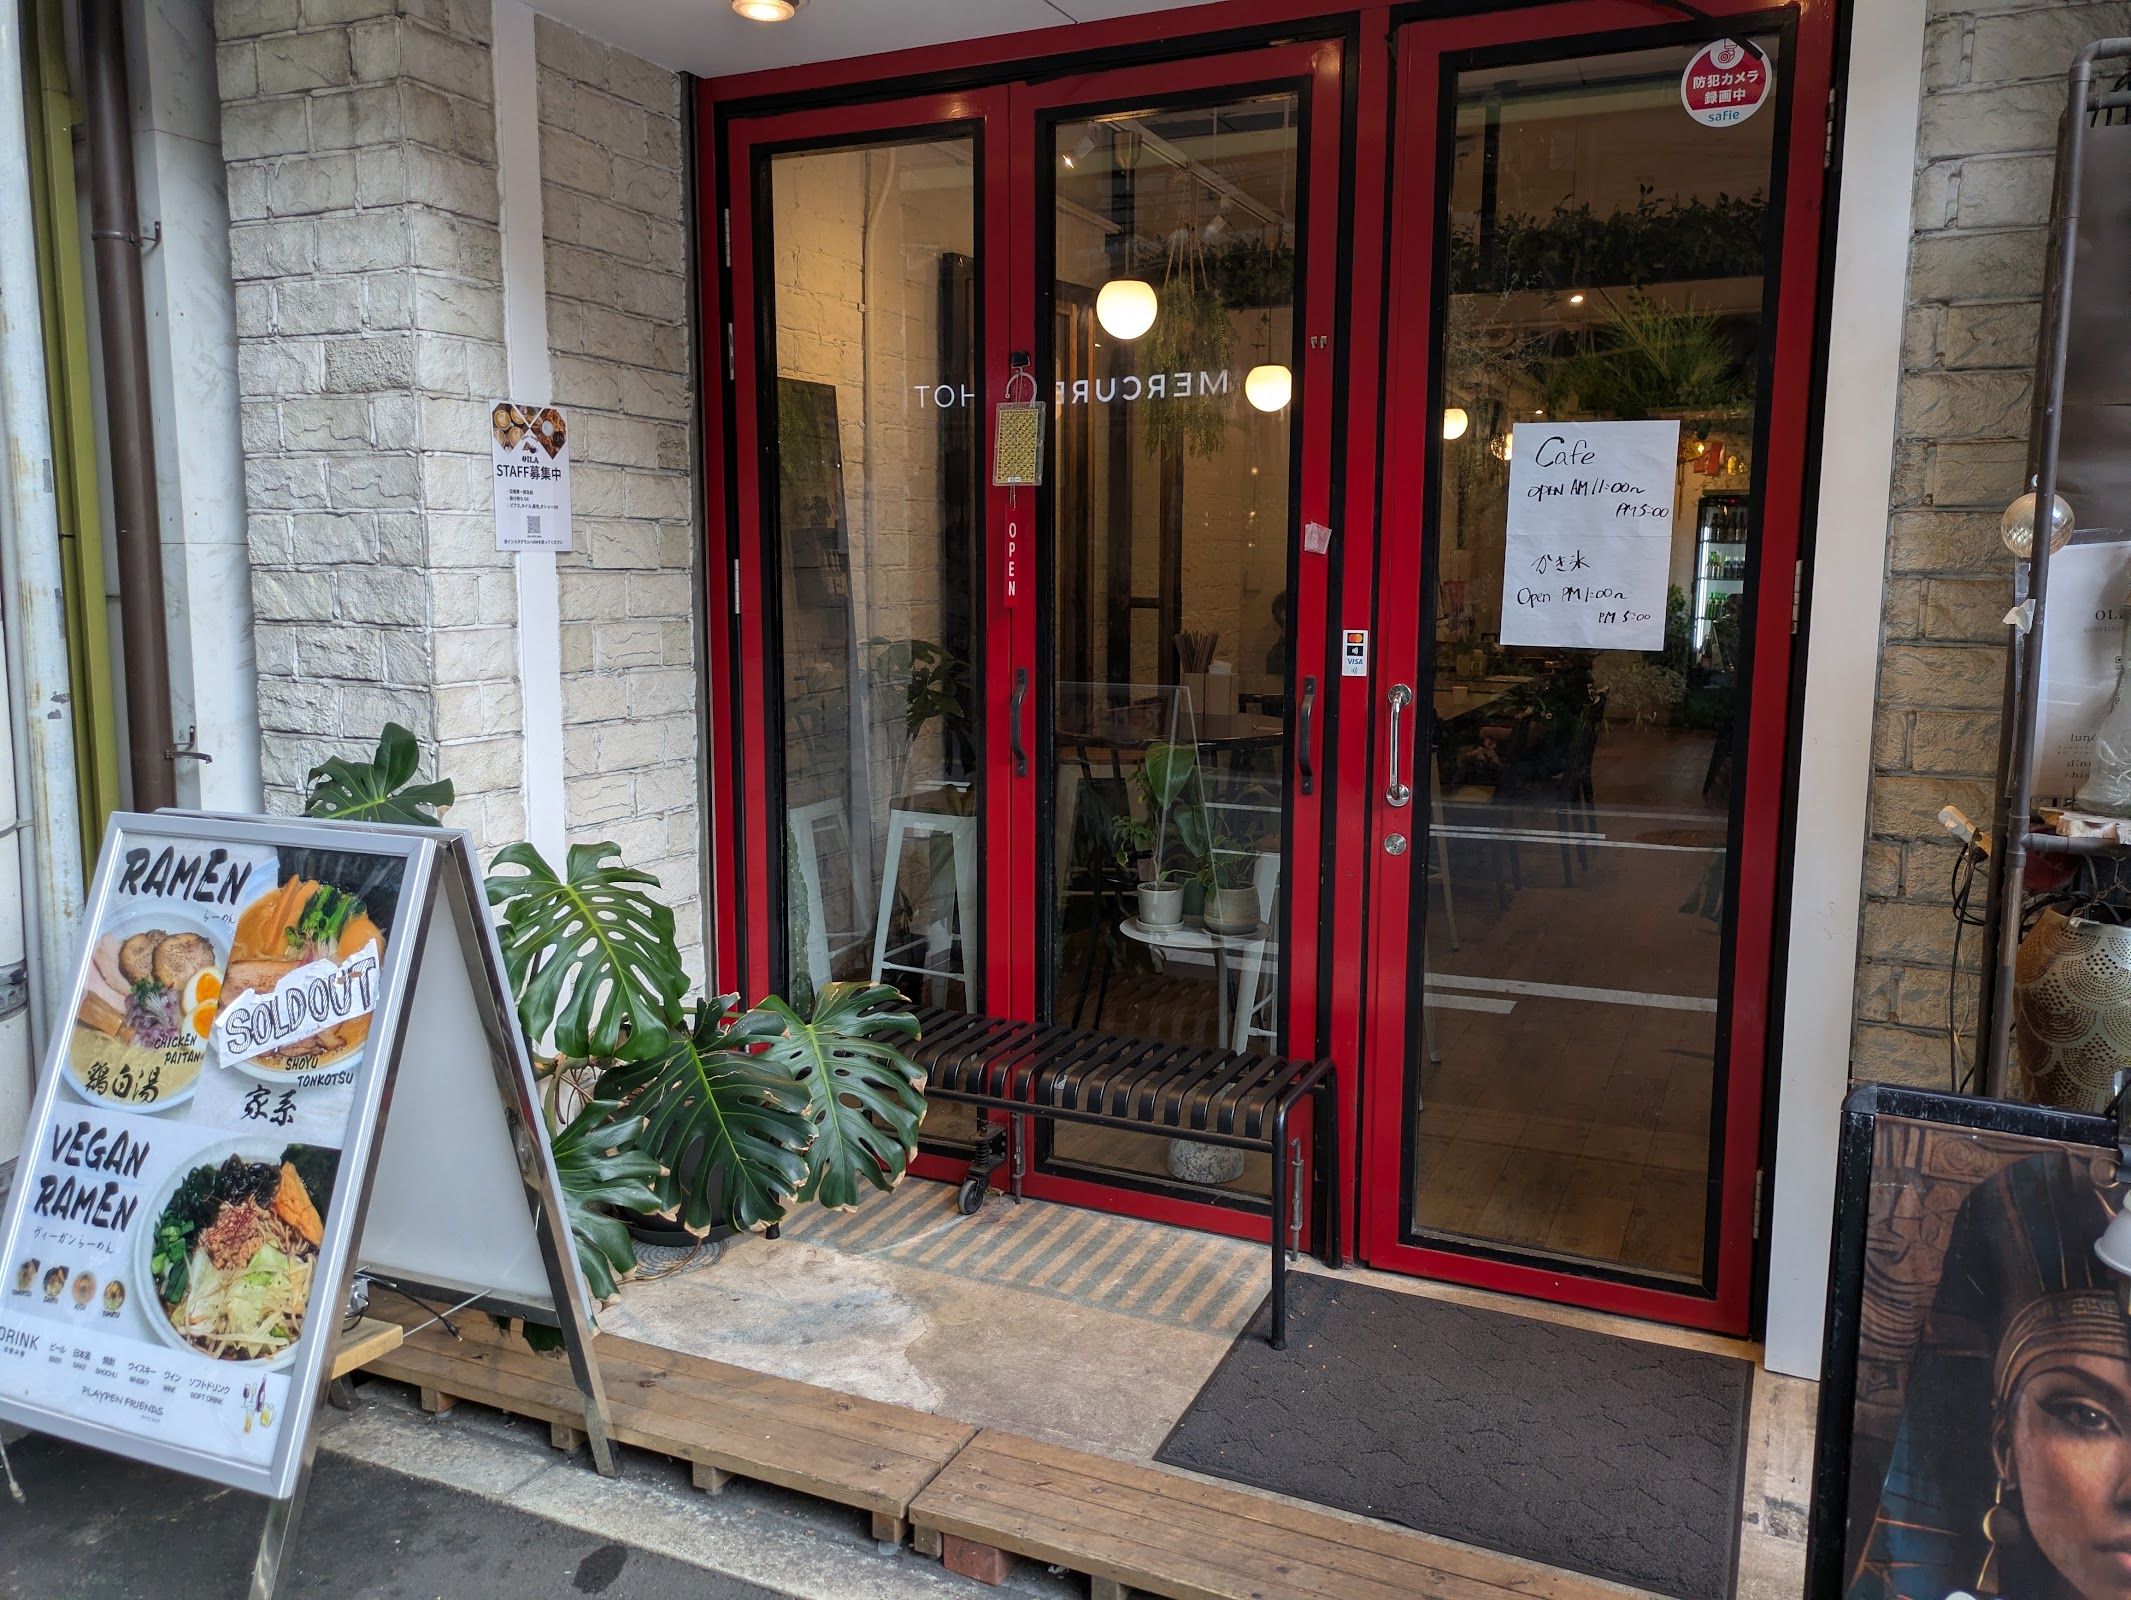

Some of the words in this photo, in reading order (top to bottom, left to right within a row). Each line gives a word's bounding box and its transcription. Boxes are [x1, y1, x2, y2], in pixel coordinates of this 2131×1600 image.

[1692, 69, 1759, 90] 防犯カメラ
[1704, 88, 1746, 105] 録画中
[1708, 109, 1740, 122] safie
[1535, 436, 1597, 468] Cafe
[496, 464, 562, 481] STAFF募集中
[1008, 522, 1017, 597] OPEN
[1517, 587, 1551, 609] Open
[118, 846, 253, 906] RAMEN
[154, 1033, 197, 1050] CHICKEN
[164, 1051, 201, 1066] PAITAN
[285, 1055, 319, 1071] SHOYU
[85, 1061, 161, 1103] 鶏白湯
[297, 1070, 354, 1088] TONKOTSU
[240, 1083, 297, 1127] 家系
[52, 1121, 150, 1179] VEGAN
[33, 1174, 139, 1233] RAMEN
